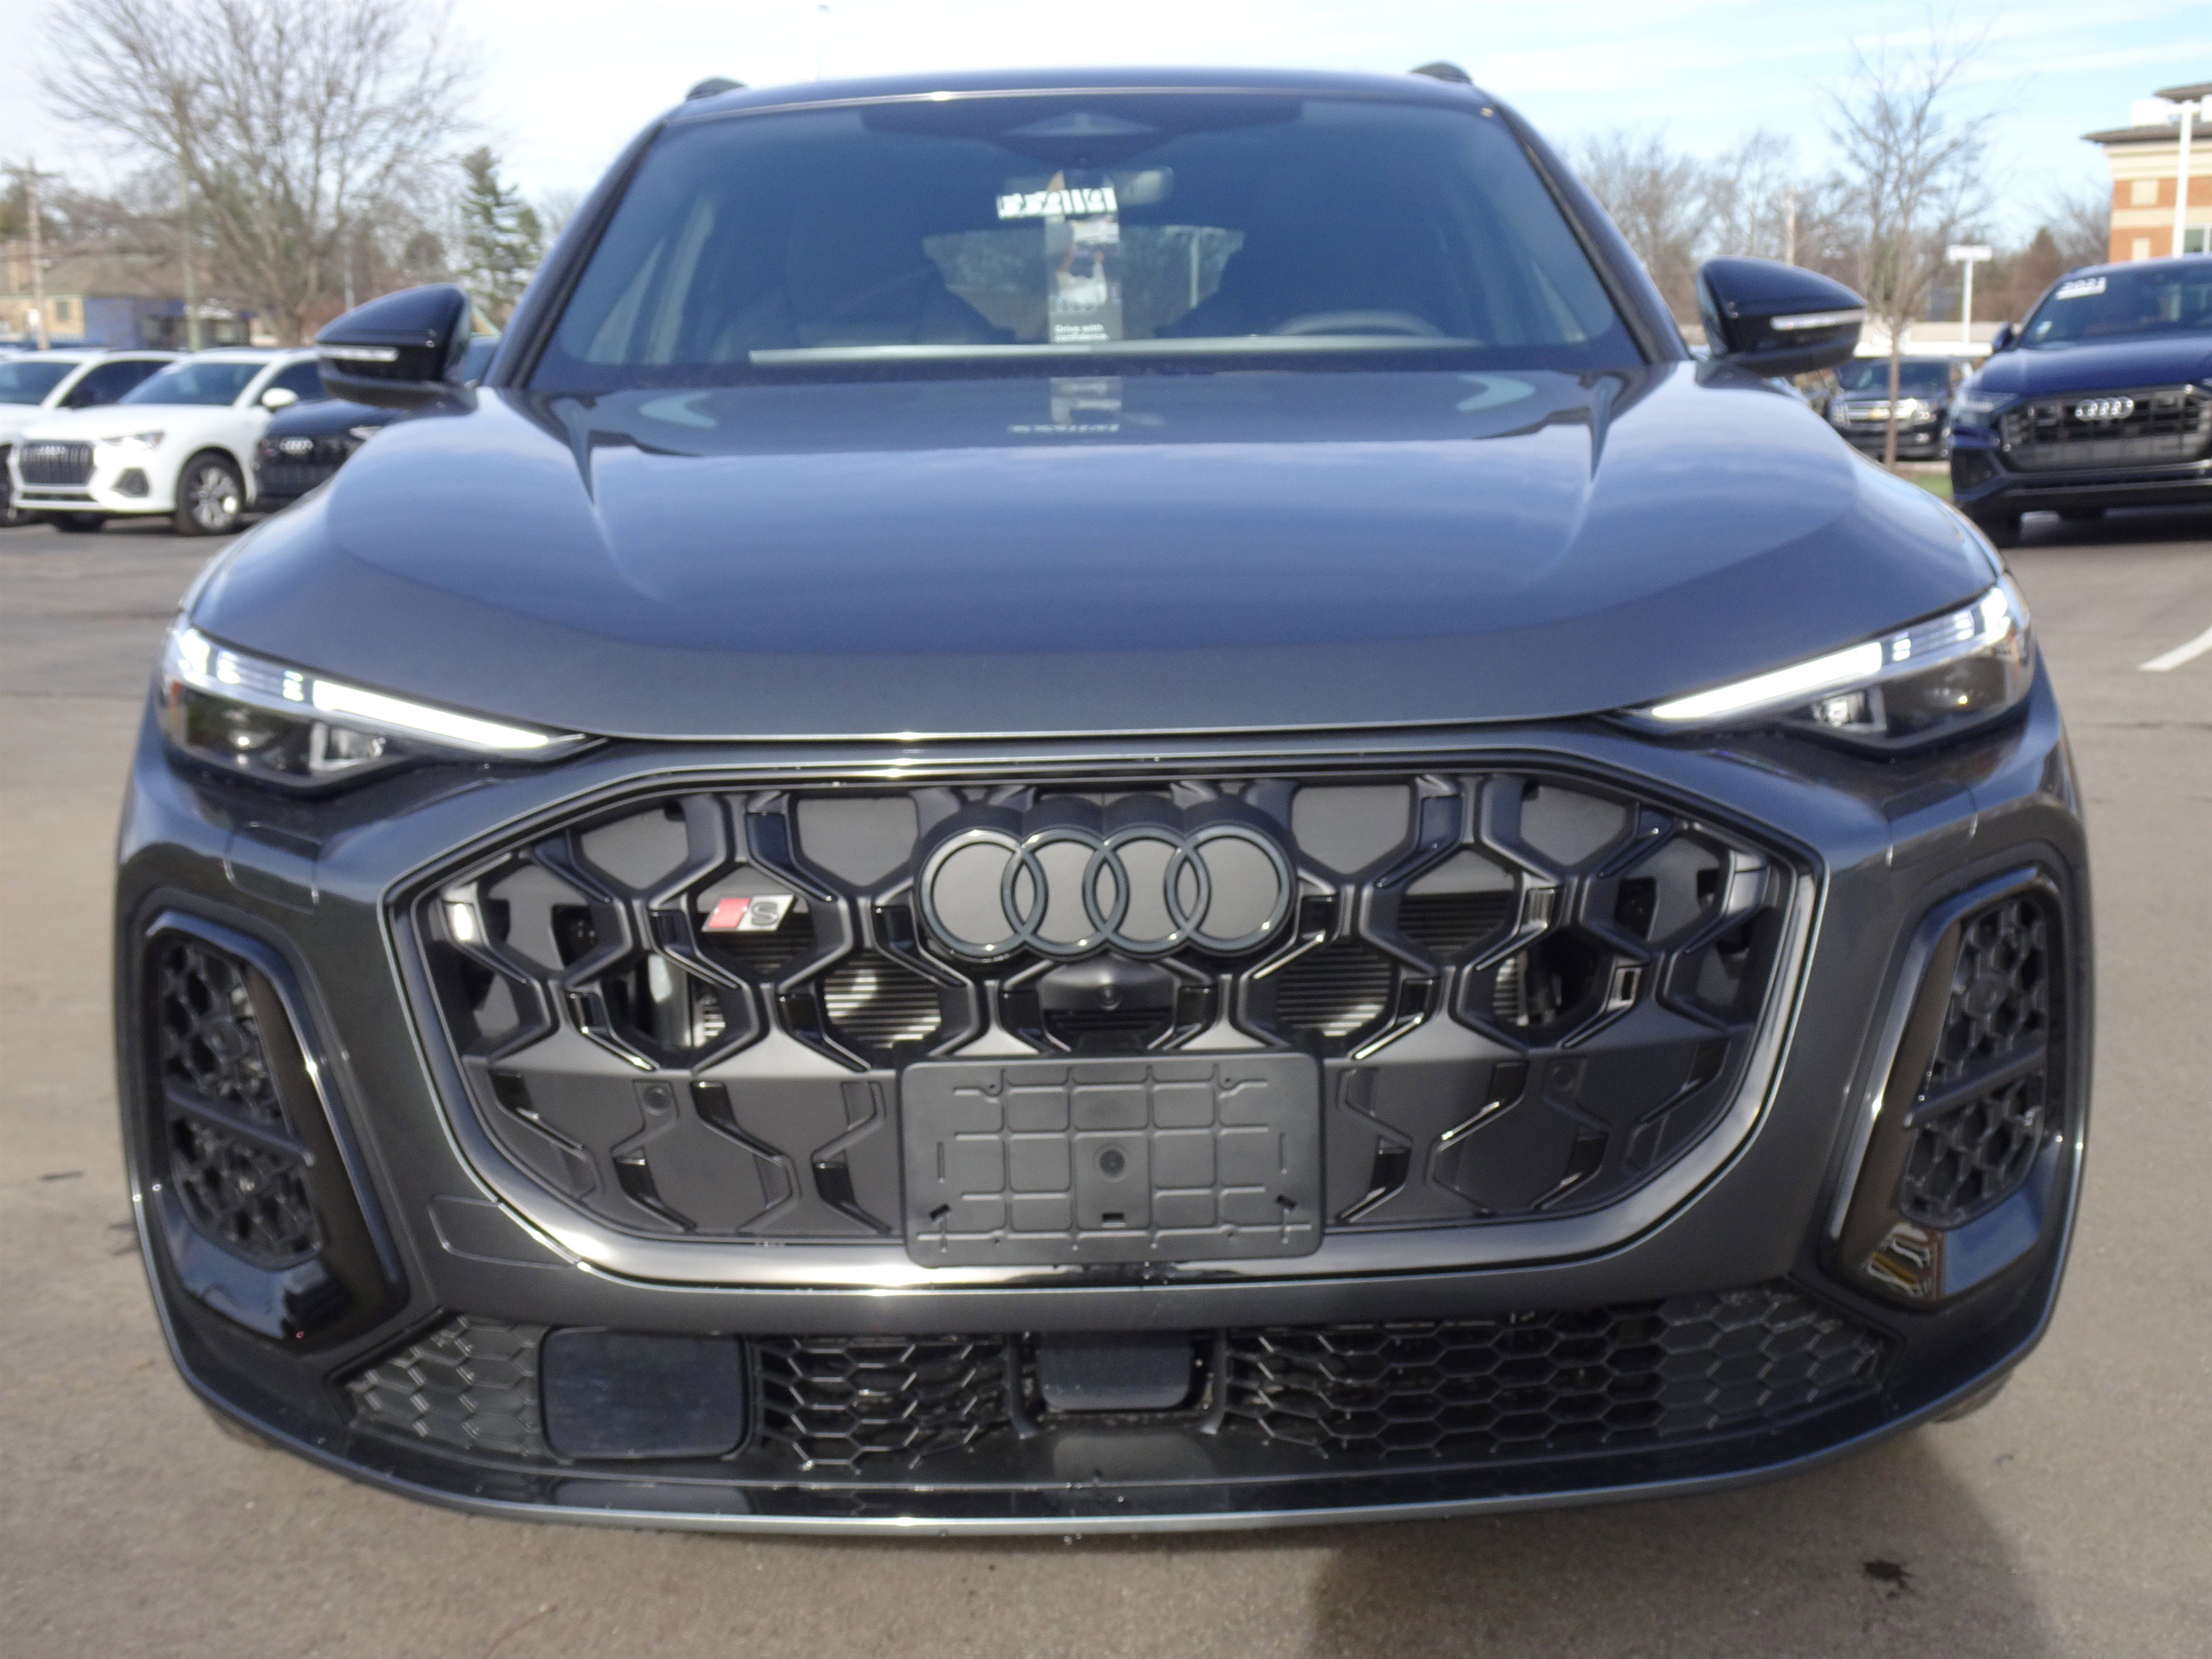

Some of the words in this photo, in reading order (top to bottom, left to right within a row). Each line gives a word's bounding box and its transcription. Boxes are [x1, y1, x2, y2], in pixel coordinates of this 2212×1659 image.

[1055, 325, 1080, 333] Drive
[1082, 324, 1104, 332] with
[751, 901, 779, 926] S
